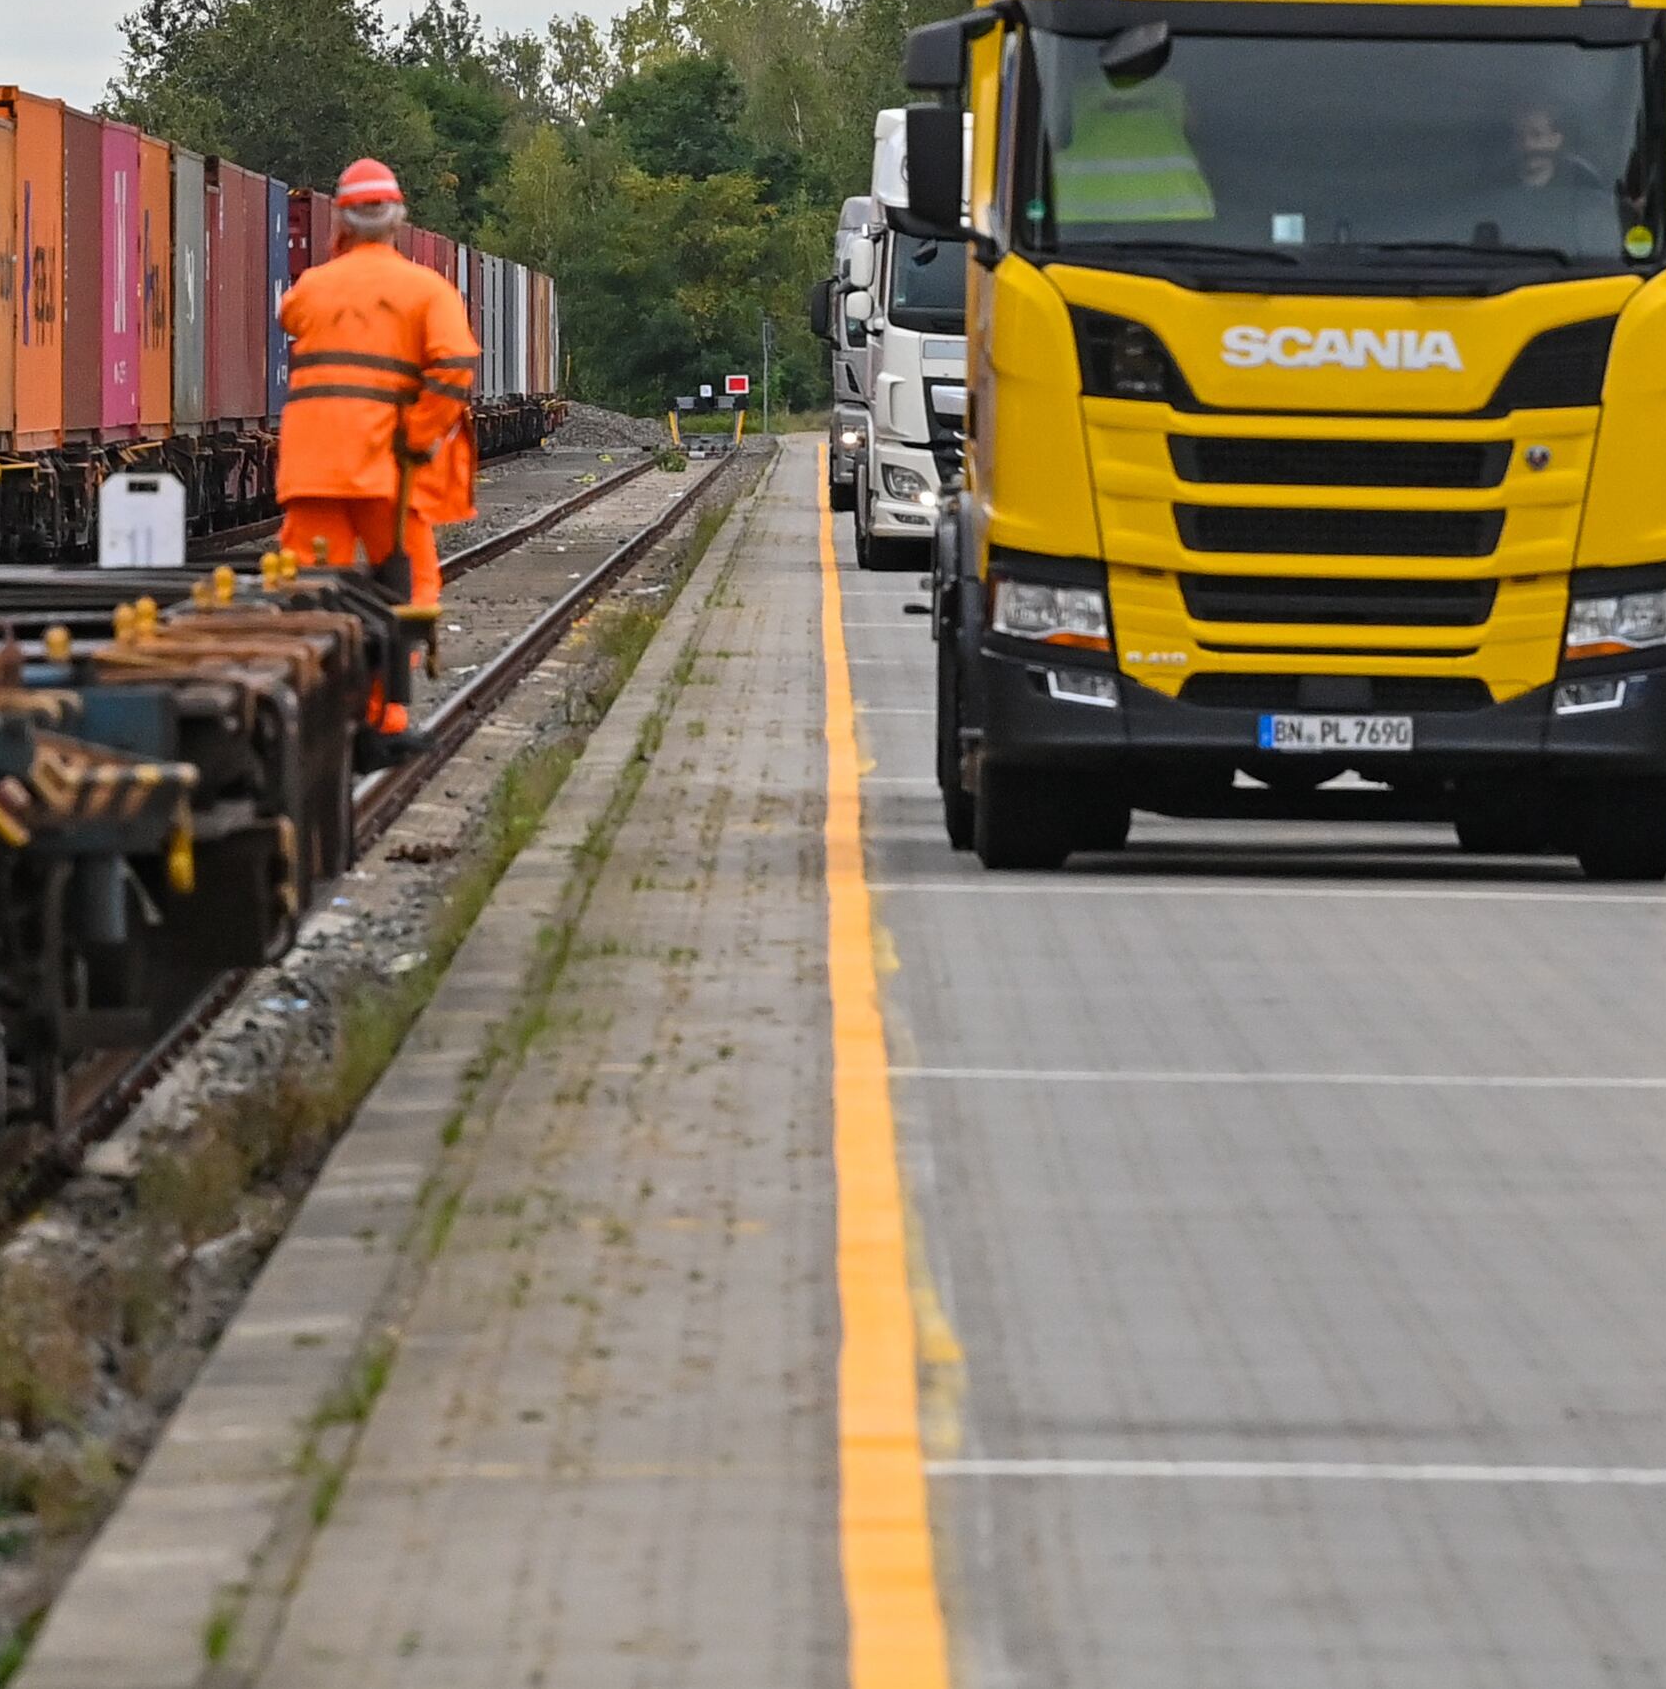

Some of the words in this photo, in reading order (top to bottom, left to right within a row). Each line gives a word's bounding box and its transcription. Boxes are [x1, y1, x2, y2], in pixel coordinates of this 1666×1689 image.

[1222, 325, 1464, 373] SCANIA
[1275, 720, 1303, 743] BN
[1320, 720, 1348, 744] PL
[1355, 720, 1408, 744] 7690
